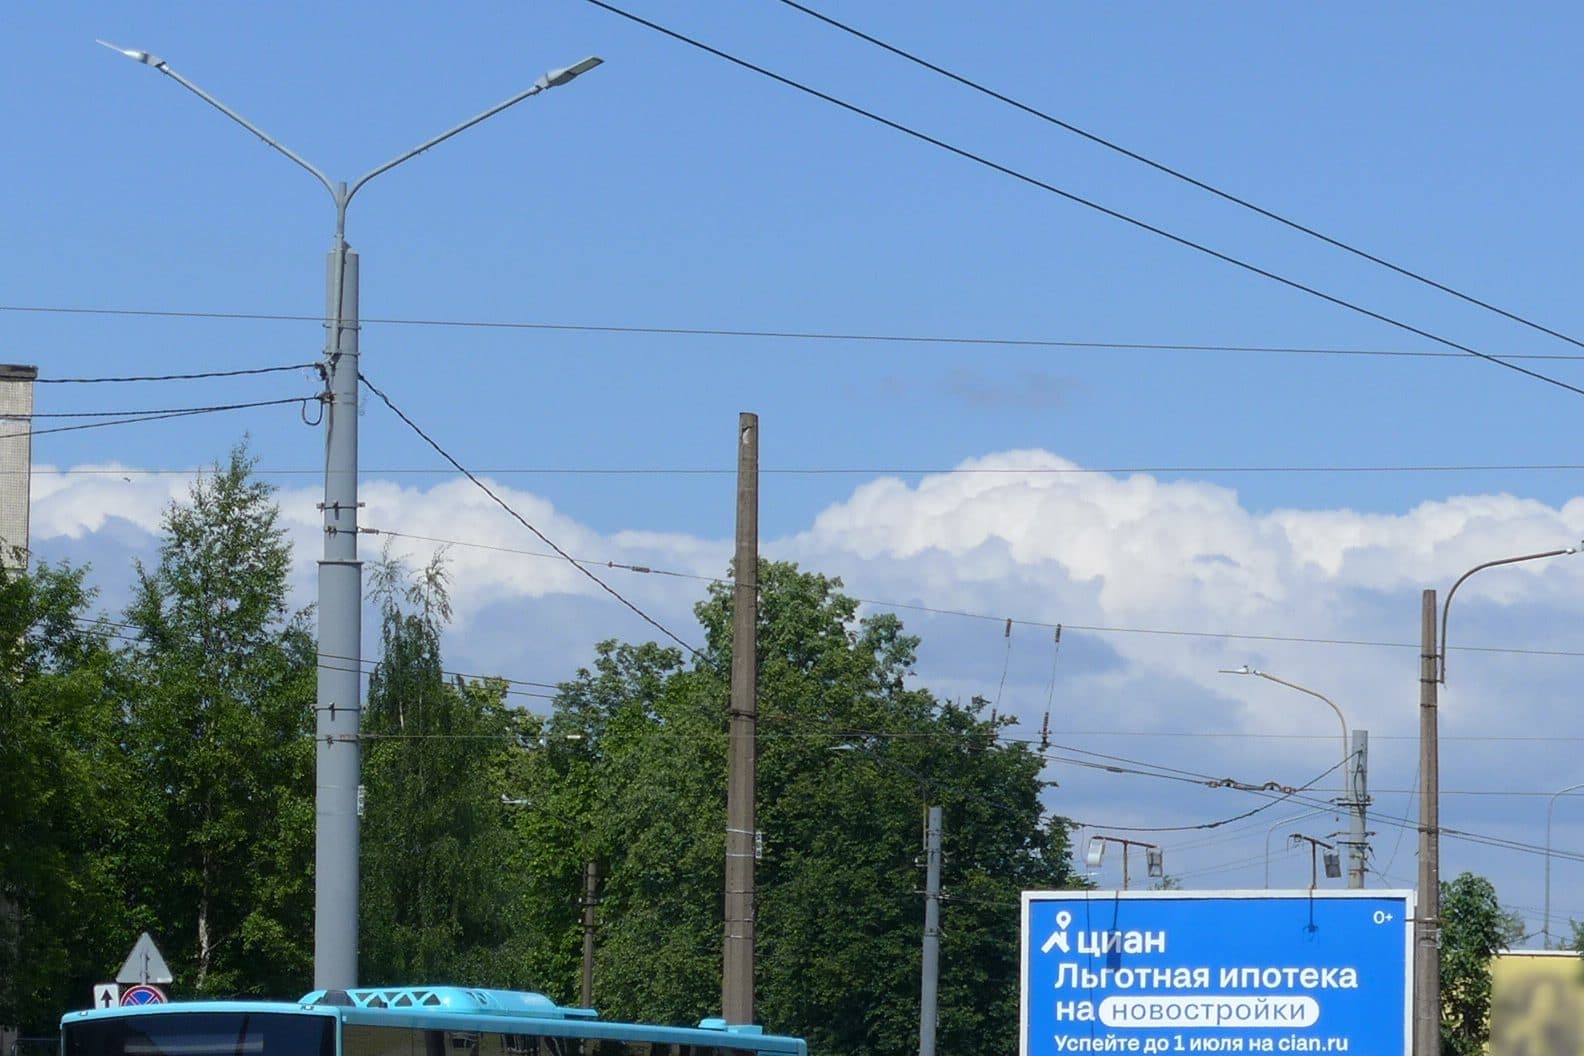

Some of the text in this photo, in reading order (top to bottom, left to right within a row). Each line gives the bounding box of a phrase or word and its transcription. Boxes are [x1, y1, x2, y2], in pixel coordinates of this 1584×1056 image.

[1373, 911, 1393, 924] 0+
[1077, 930, 1166, 957] циан
[1055, 964, 1358, 989] Льготная ипотека
[1056, 998, 1306, 1025] на новостройки
[1054, 1034, 1349, 1054] Успейте до 1 июля на cian.ru
